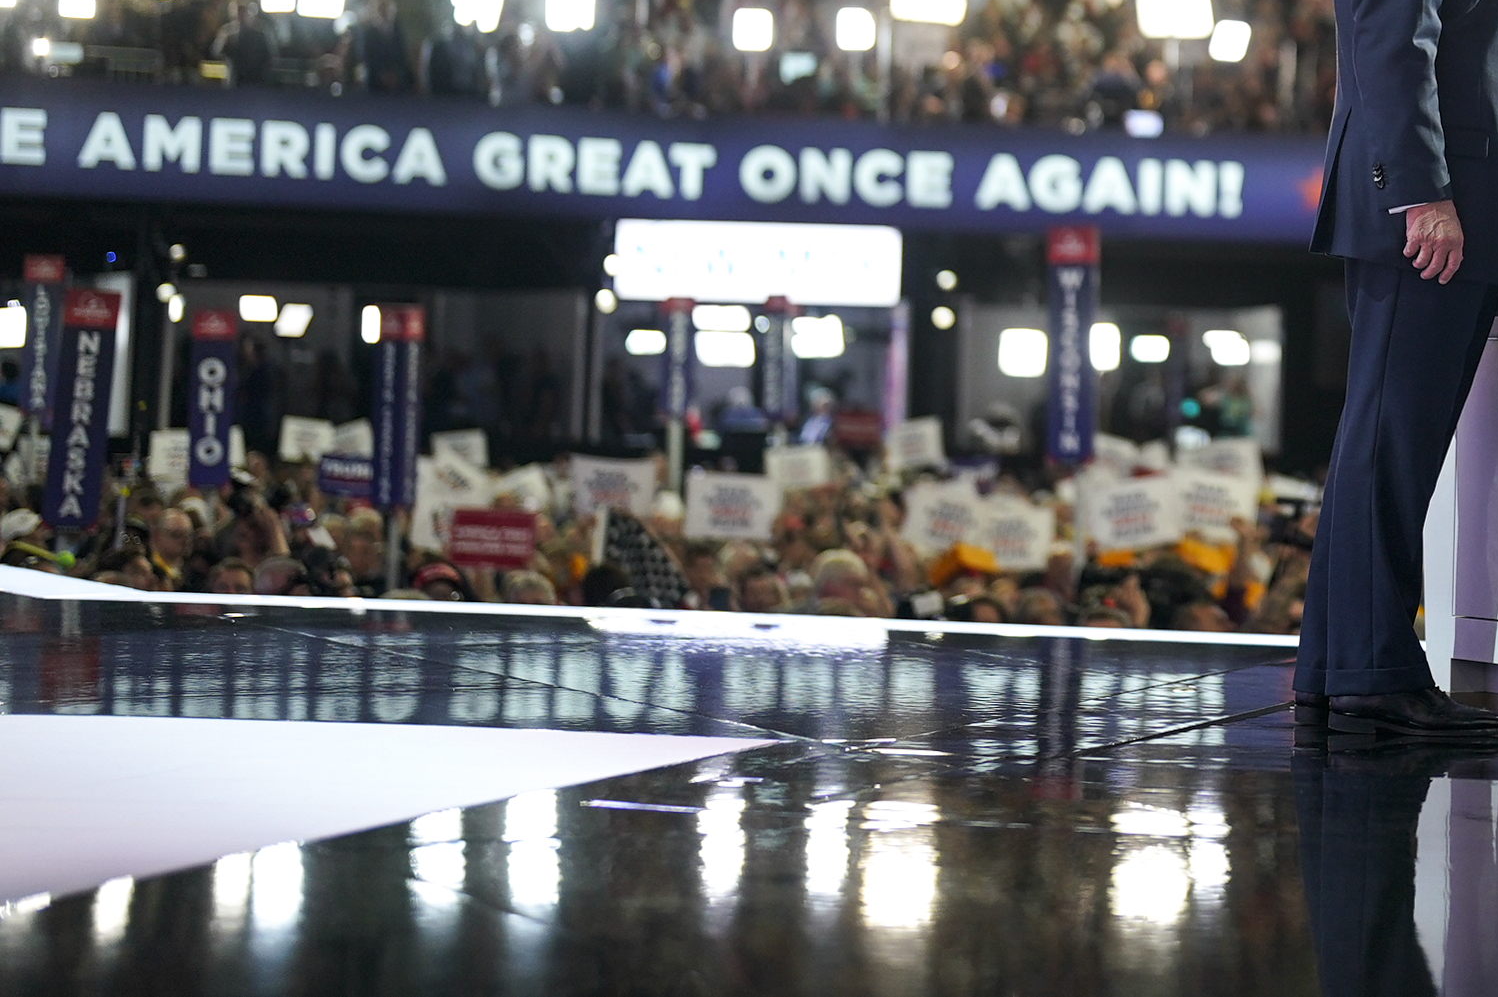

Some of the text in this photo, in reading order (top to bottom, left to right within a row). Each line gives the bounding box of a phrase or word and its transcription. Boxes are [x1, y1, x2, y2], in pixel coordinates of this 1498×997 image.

[79, 112, 446, 186] AMERICA
[473, 133, 718, 198] GREAT
[738, 146, 954, 206] ONCE
[975, 155, 1245, 218] AGAIN!
[57, 330, 100, 519] NEBRASKA
[196, 357, 227, 466] OHIO
